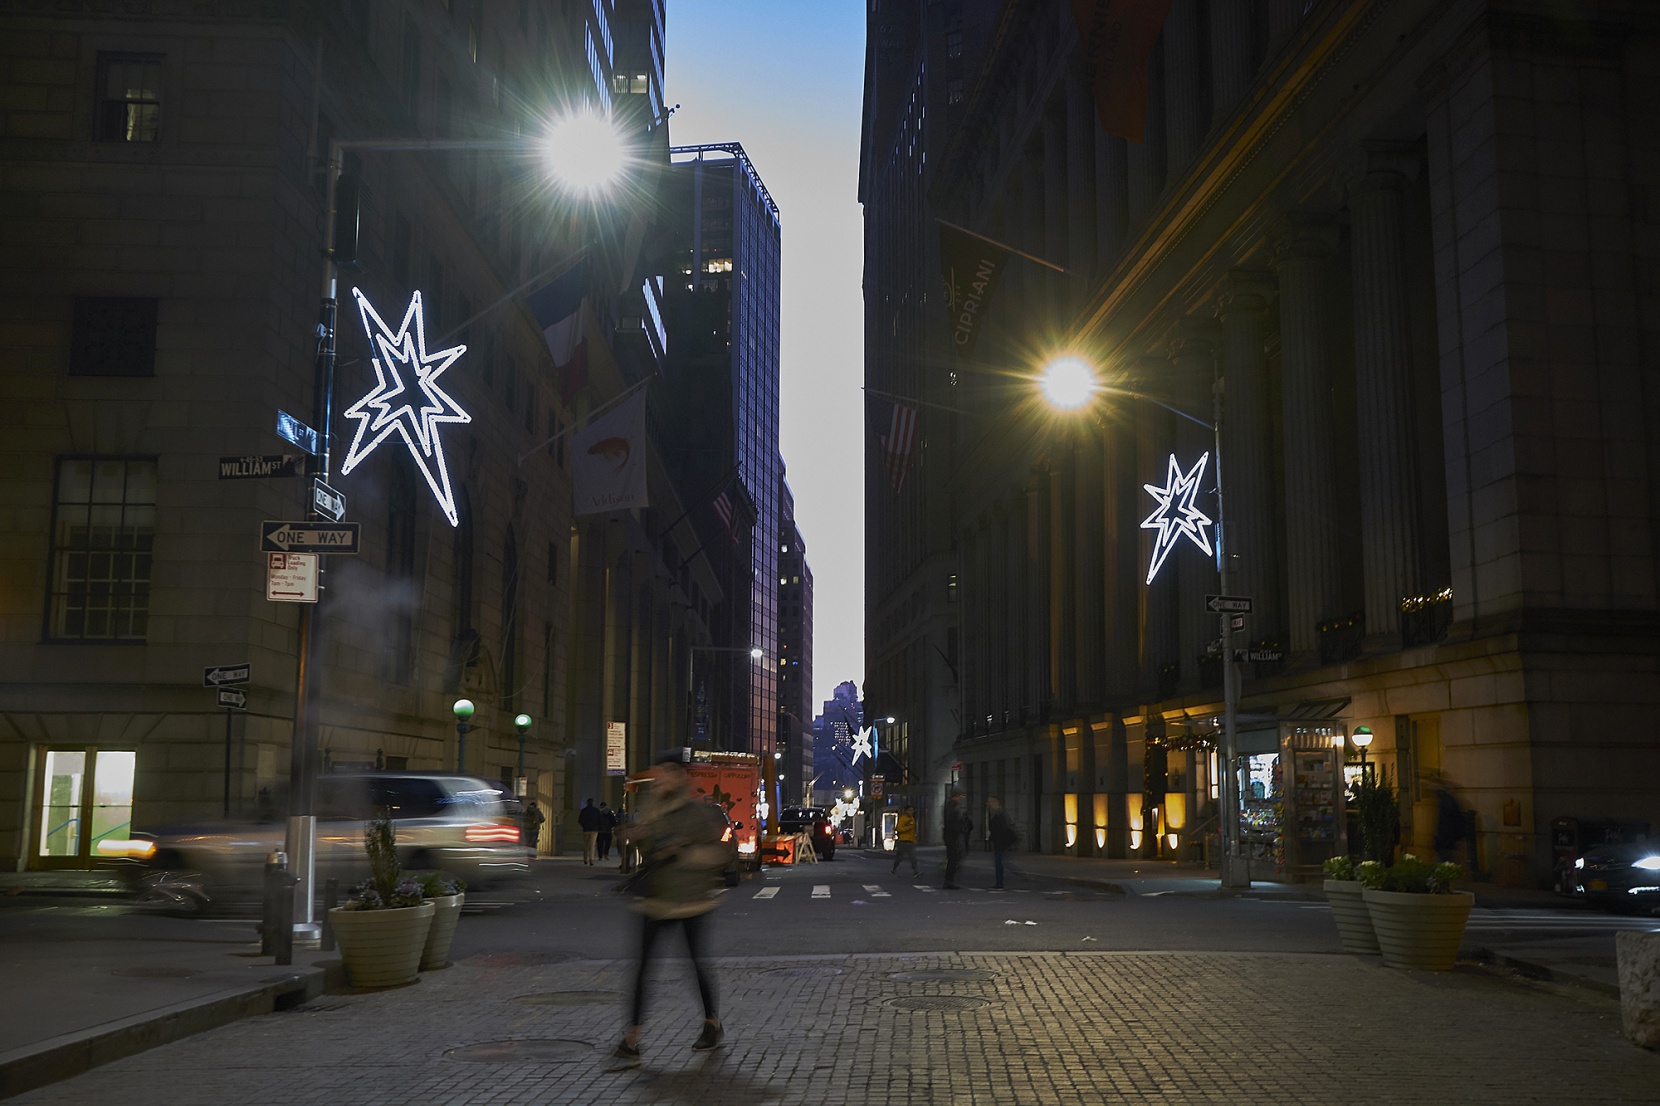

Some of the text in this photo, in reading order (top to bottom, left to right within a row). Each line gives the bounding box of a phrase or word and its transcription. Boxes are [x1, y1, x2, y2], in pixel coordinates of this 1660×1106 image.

[954, 258, 995, 345] CIPRIANI
[221, 461, 282, 477] WILLIAM ST
[317, 490, 327, 507] ONE
[277, 531, 347, 544] ONE WAY
[1249, 652, 1278, 662] WILLIAM
[212, 670, 245, 680] ONE WAY
